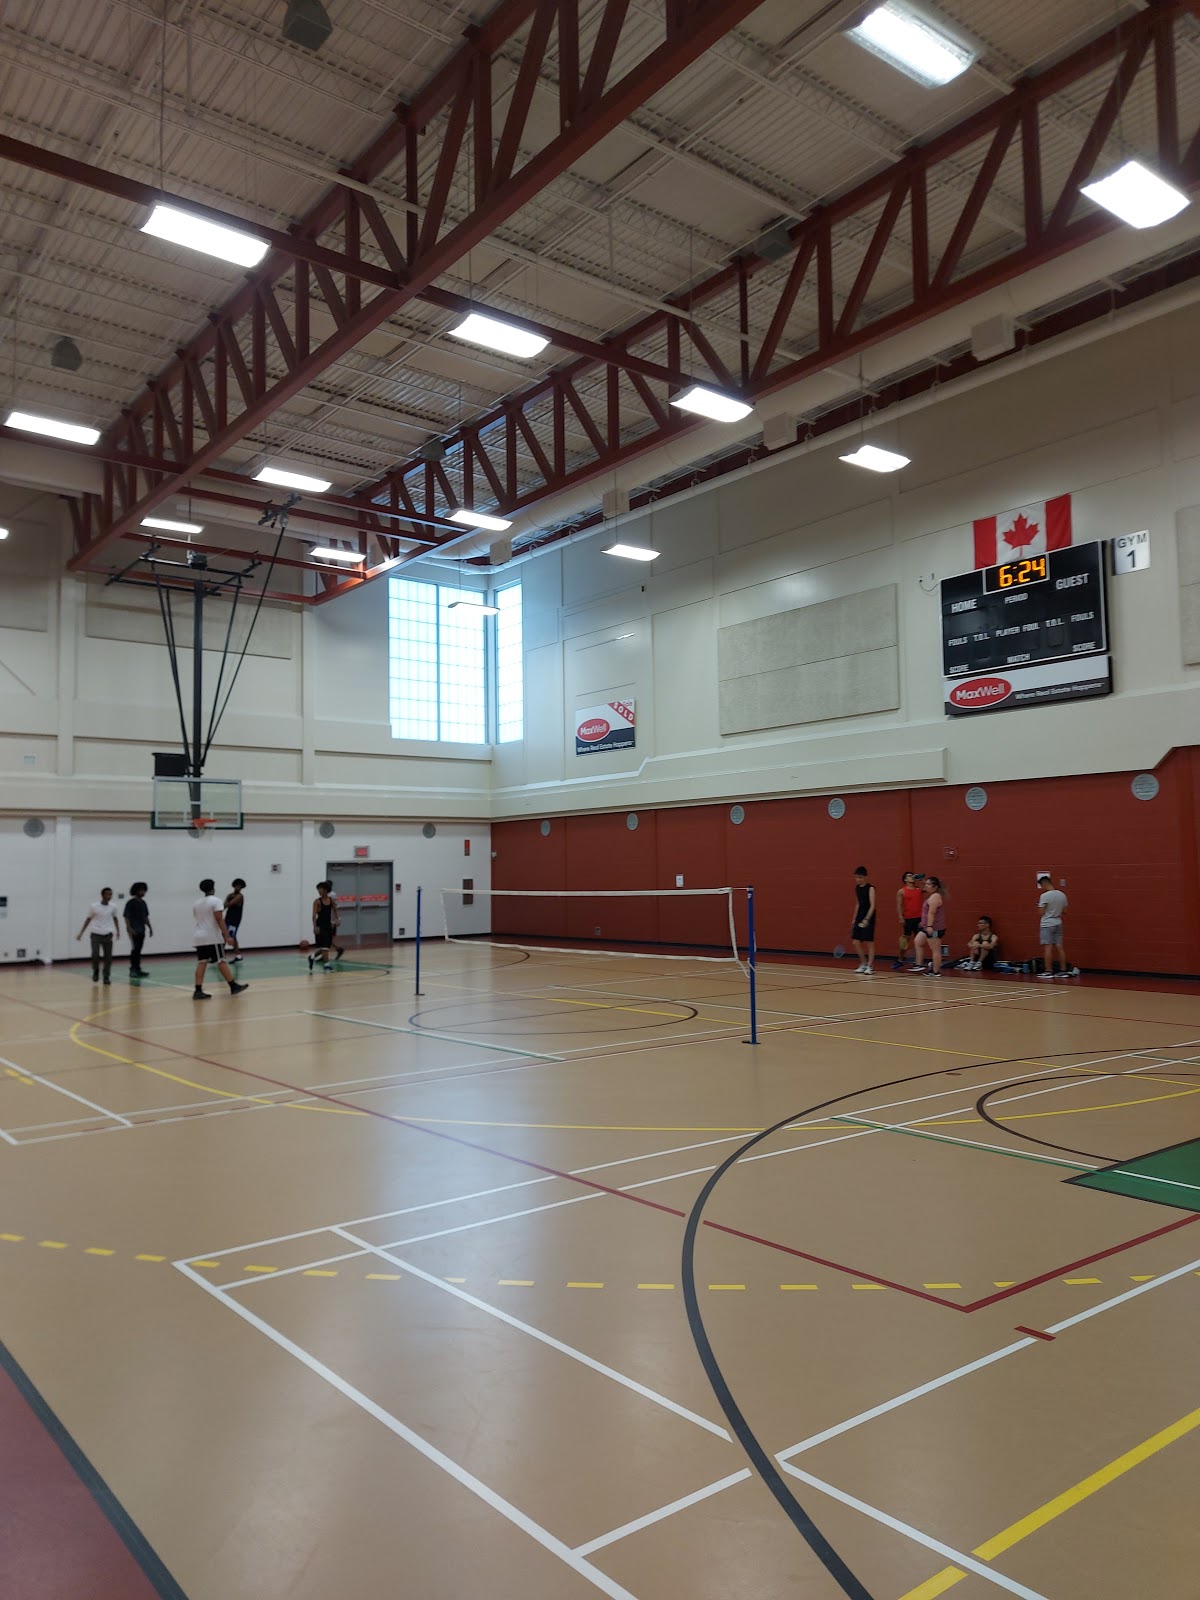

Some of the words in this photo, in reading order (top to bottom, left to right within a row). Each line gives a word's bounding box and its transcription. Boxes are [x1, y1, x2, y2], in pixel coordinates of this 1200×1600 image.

[1118, 532, 1147, 548] GYM
[1126, 549, 1136, 568] 1
[999, 558, 1046, 588] 6:24
[1055, 572, 1090, 590] GUEST
[951, 598, 977, 614] HOME
[1004, 592, 1028, 604] PERIOD
[1070, 611, 1094, 623] FOULS
[996, 626, 1020, 638] PLAYER
[1022, 622, 1040, 633] FOUL
[948, 636, 968, 647] FOULS
[1072, 641, 1096, 653] SCORE
[949, 663, 970, 674] SCORE
[956, 682, 1006, 702] MaxWell
[1016, 692, 1036, 700] Where
[1036, 689, 1050, 698] Real
[613, 702, 634, 720] SOLD
